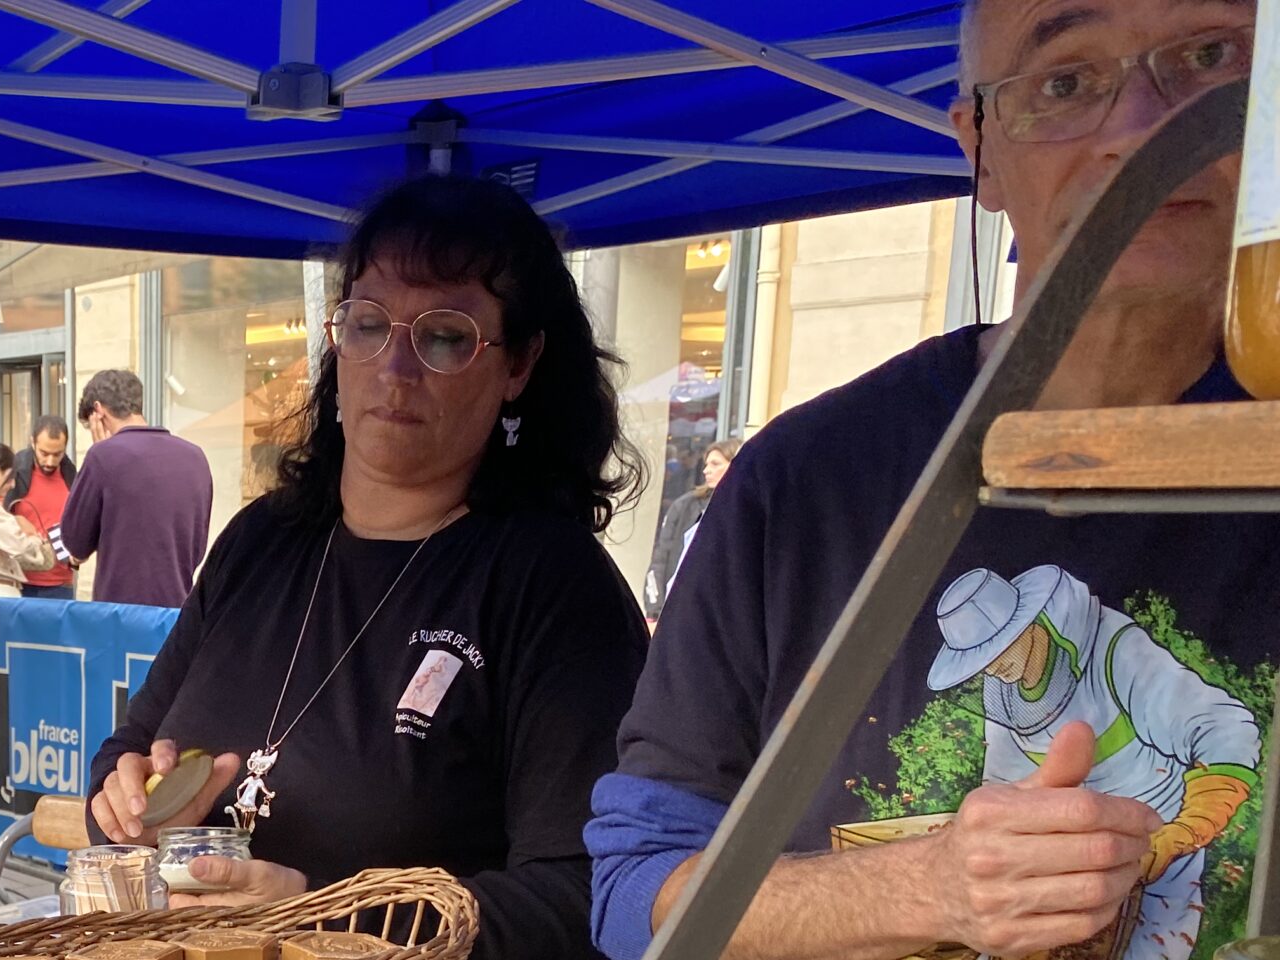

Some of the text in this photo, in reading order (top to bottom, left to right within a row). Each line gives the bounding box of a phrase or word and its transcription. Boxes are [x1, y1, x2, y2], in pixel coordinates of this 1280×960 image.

[409, 629, 486, 670] LE RUCHER DE JACKY
[11, 727, 78, 793] bleu
